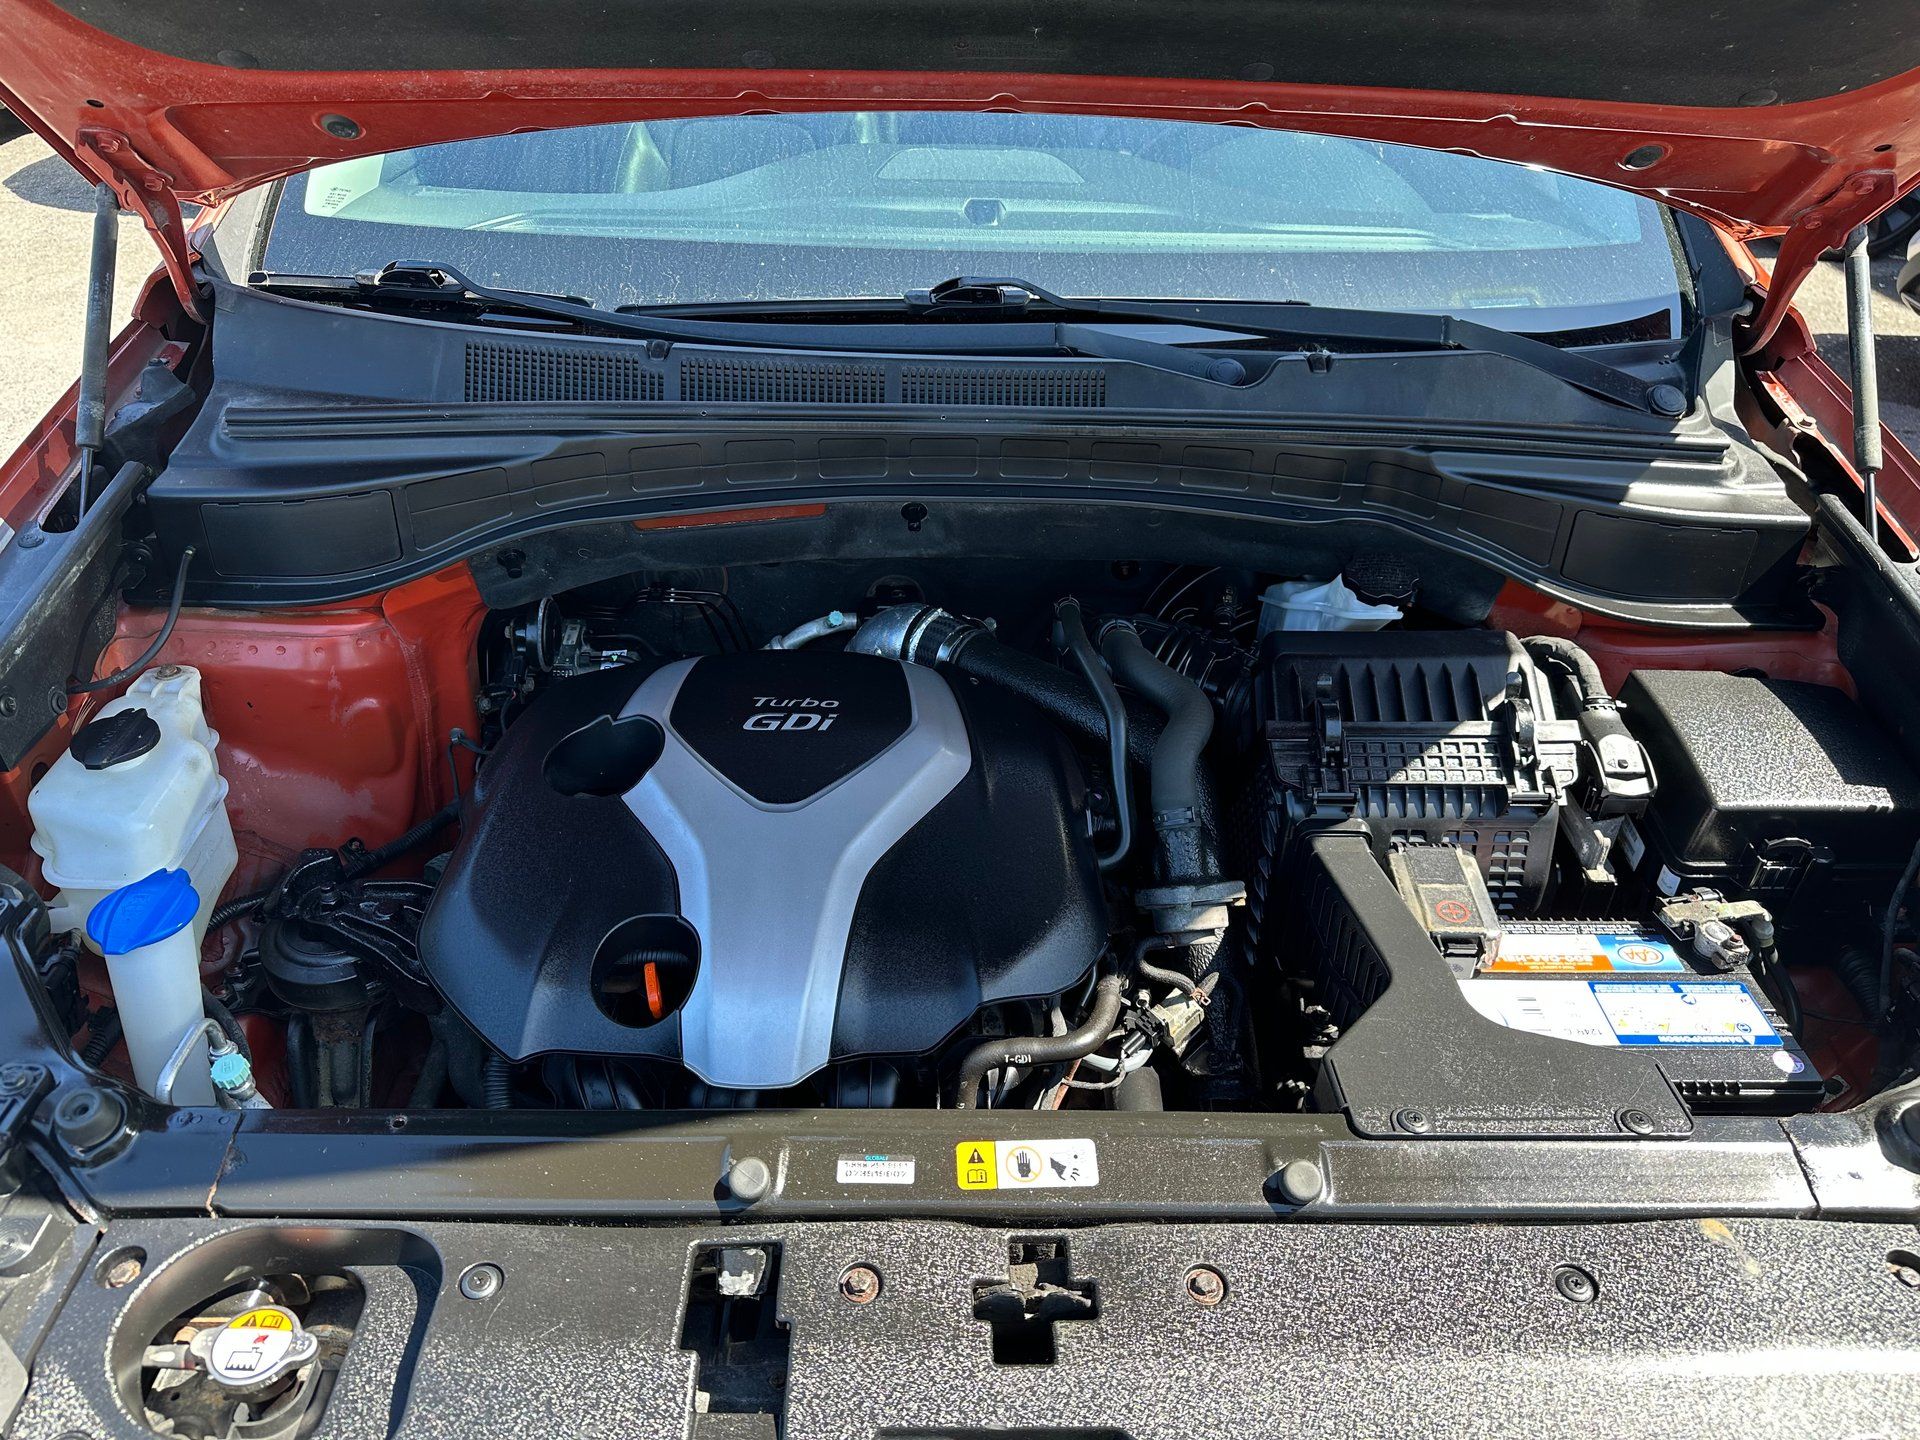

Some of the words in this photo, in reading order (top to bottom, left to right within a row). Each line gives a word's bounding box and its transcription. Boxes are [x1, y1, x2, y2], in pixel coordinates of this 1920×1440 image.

[753, 696, 840, 708] Turbo
[742, 712, 839, 731] GDi
[1622, 949, 1660, 963] CAA
